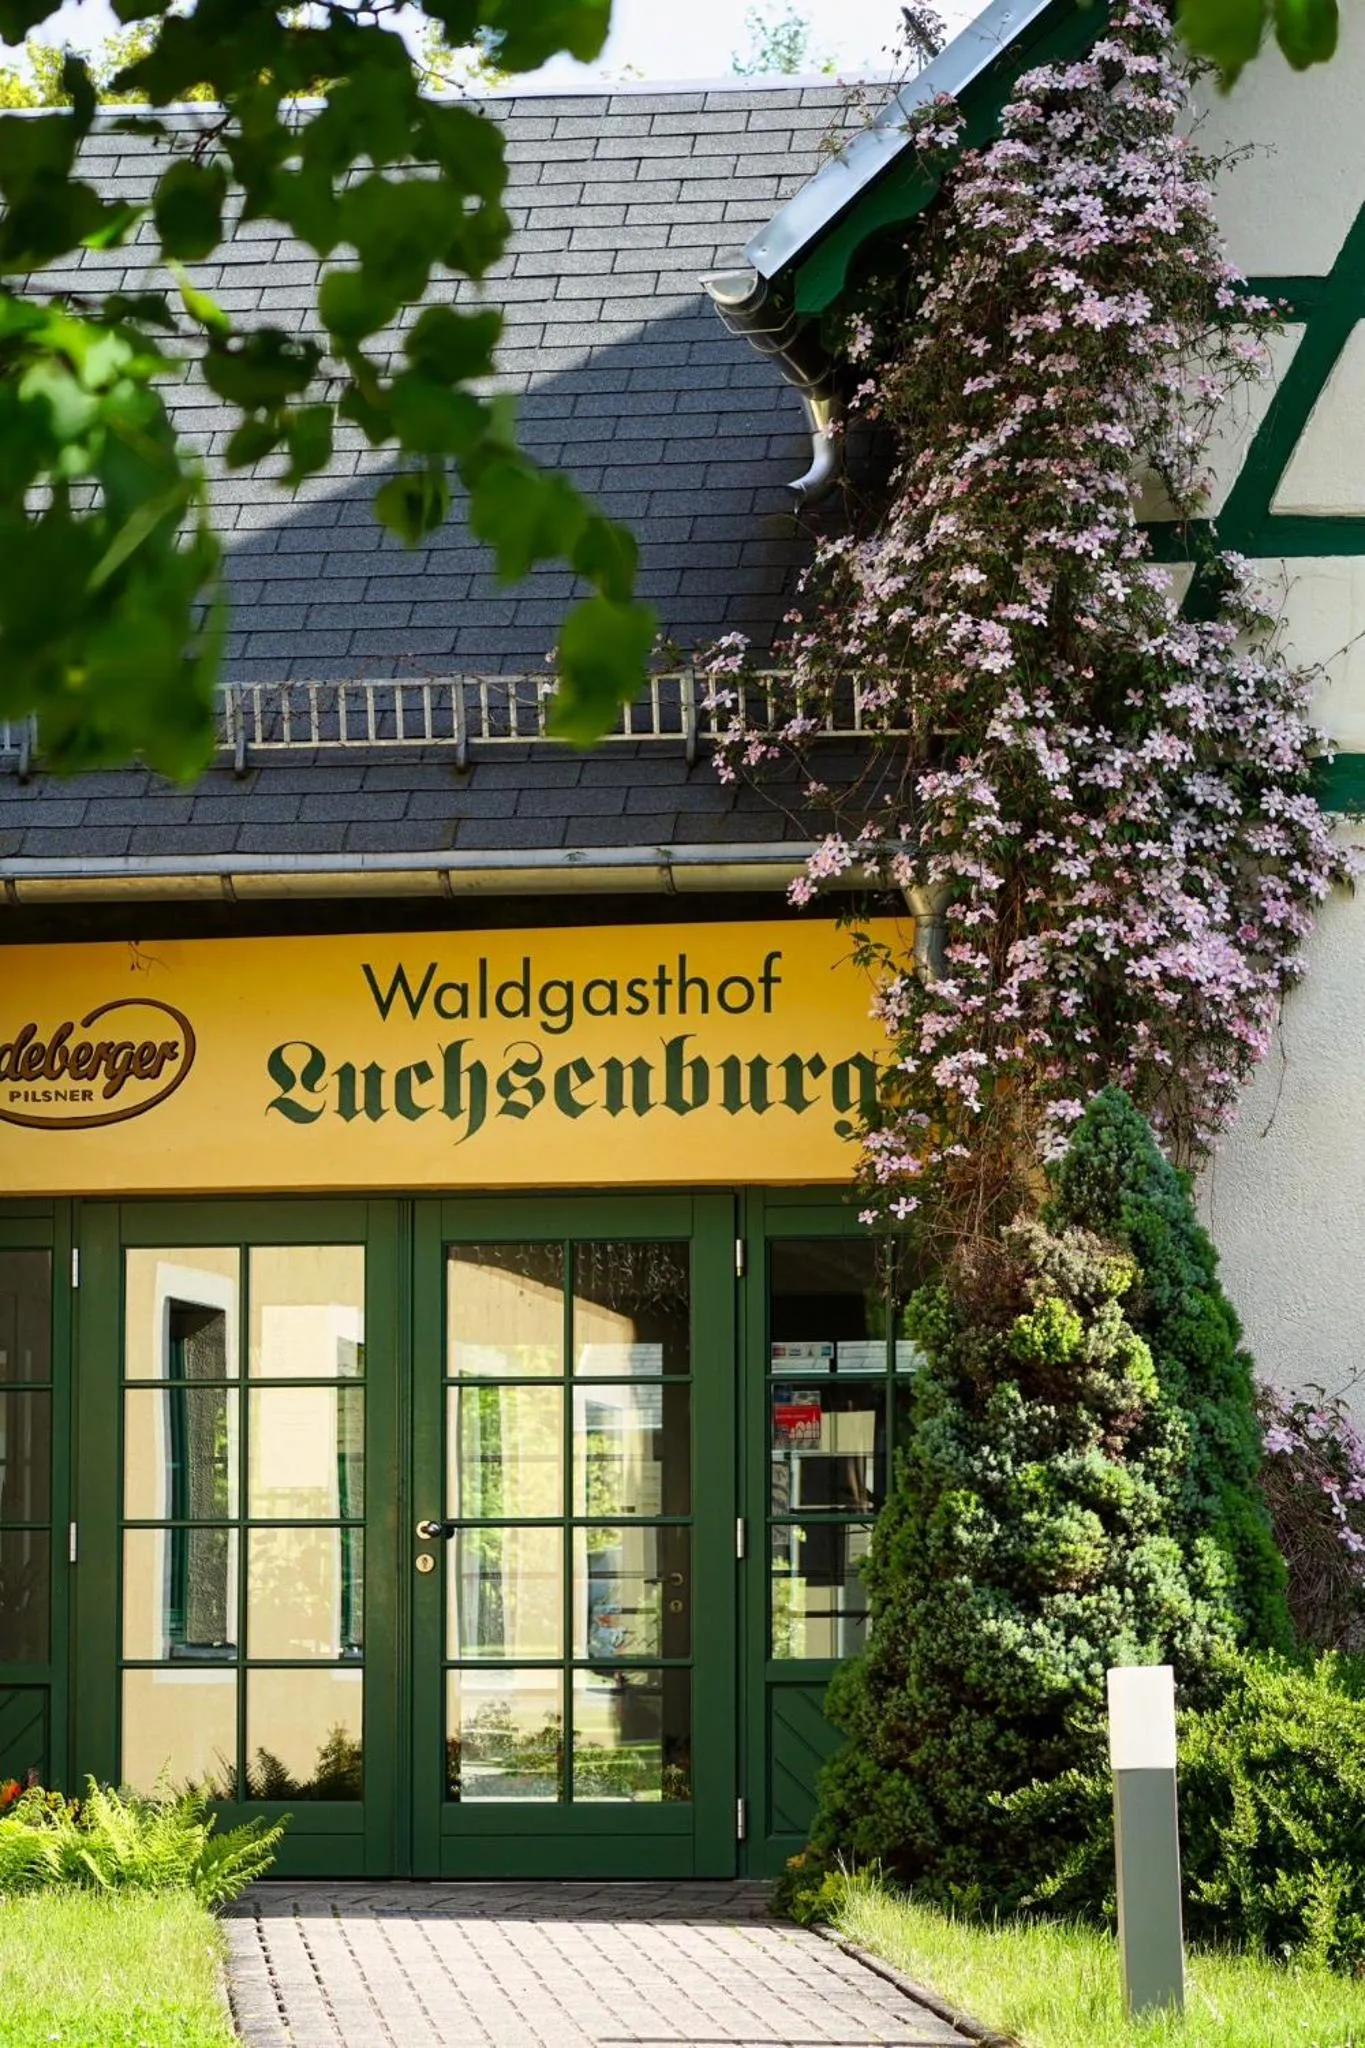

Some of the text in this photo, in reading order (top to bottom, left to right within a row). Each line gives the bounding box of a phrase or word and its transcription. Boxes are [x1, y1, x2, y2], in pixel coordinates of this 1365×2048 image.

[361, 951, 782, 1034] Waldgasthof
[9, 1089, 94, 1102] PILSNER
[265, 1034, 881, 1145] Luchsenburg
